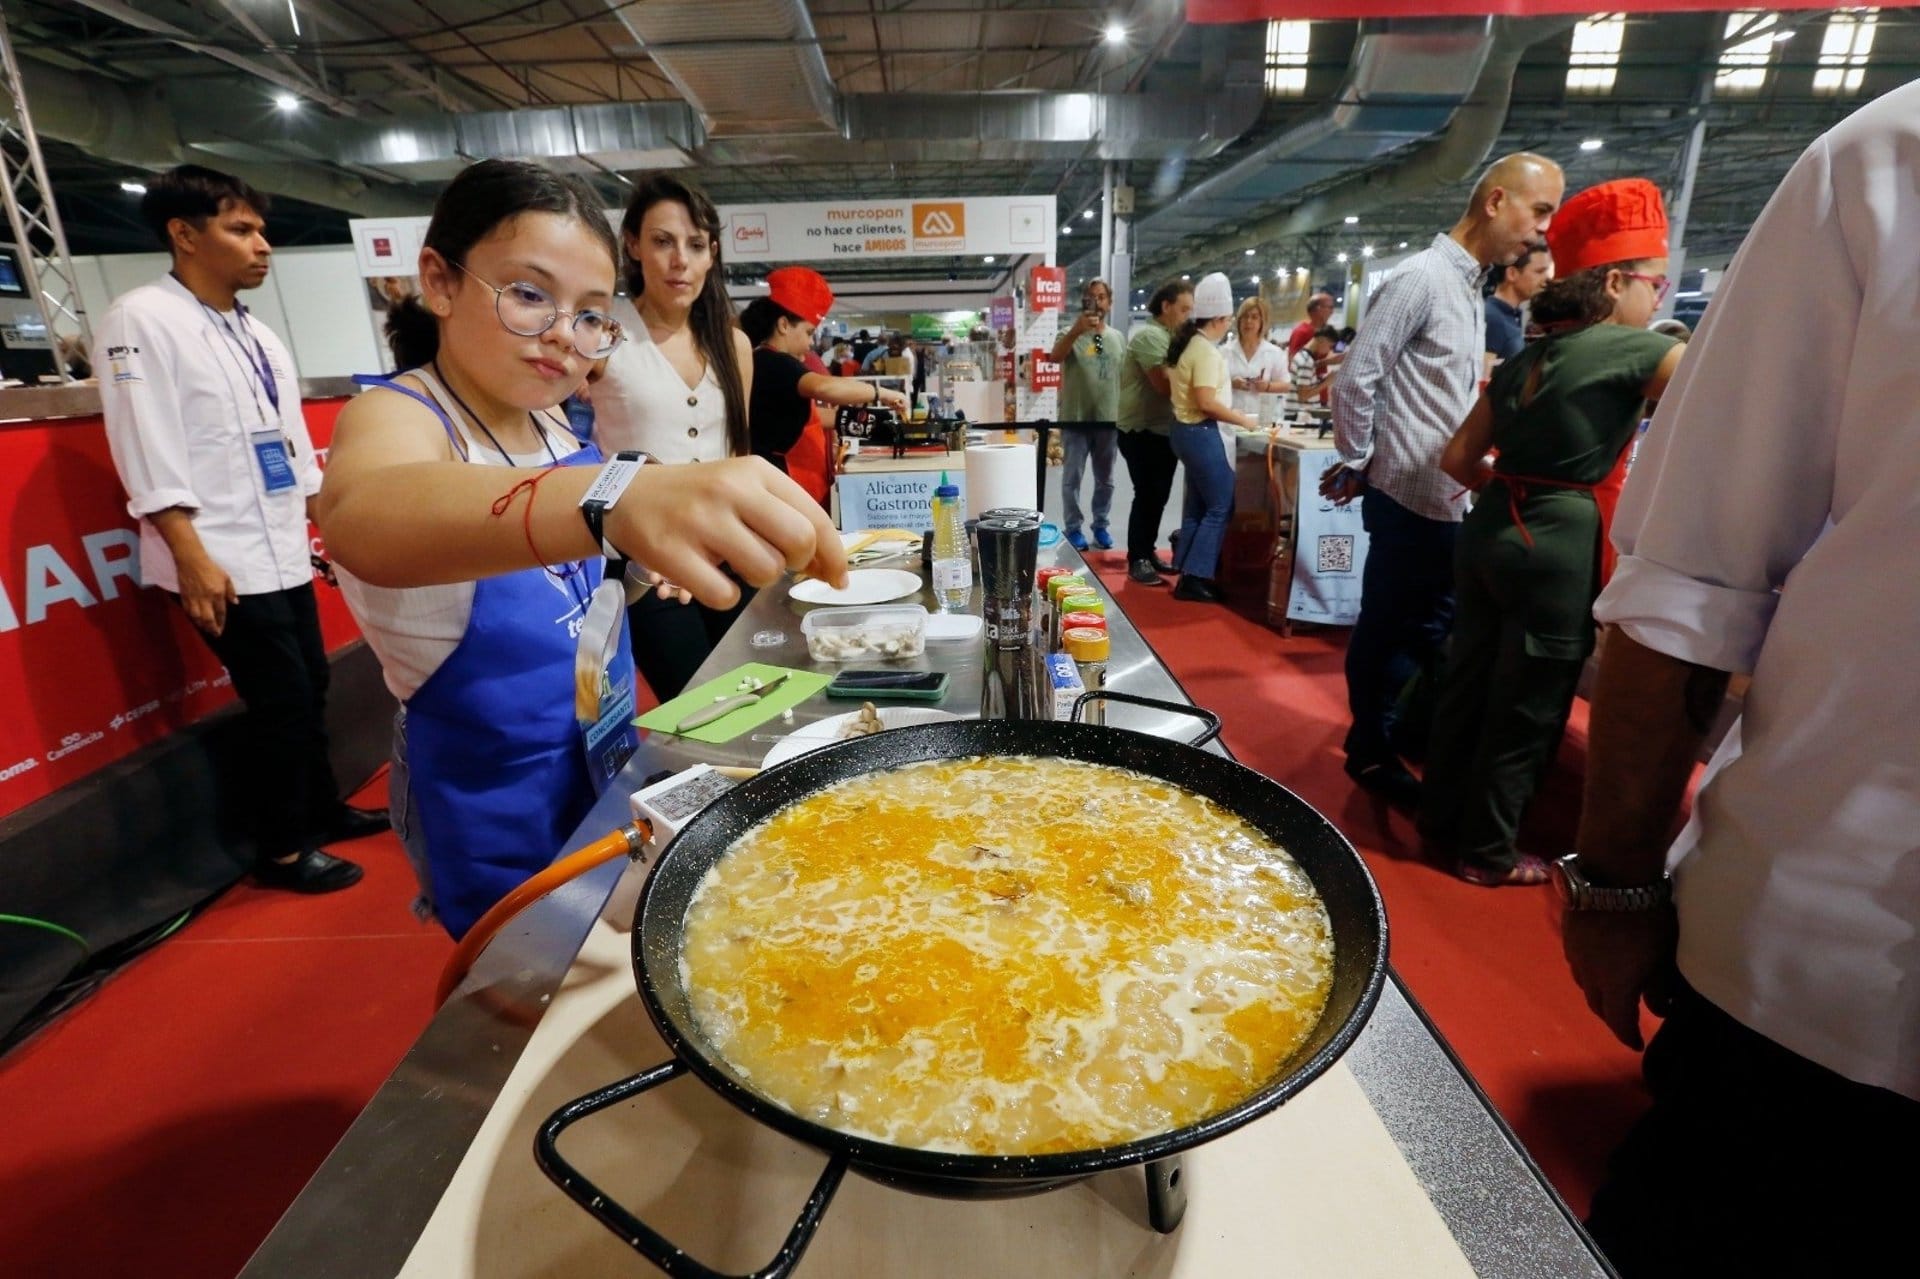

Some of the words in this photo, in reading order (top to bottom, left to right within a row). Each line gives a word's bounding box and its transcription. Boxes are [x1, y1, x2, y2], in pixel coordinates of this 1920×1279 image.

[827, 207, 904, 221] murcopan
[807, 228, 822, 237] no
[824, 223, 853, 236] hace
[856, 223, 906, 236] clientes,
[833, 241, 862, 253] hace
[865, 239, 906, 251] AMIGOS
[1036, 278, 1062, 293] irca
[1036, 295, 1062, 303] GROUP
[866, 482, 928, 495] Alicante
[0, 528, 154, 632] AR
[589, 700, 632, 744] CONCURSANTE
[46, 730, 105, 762] Carmencita
